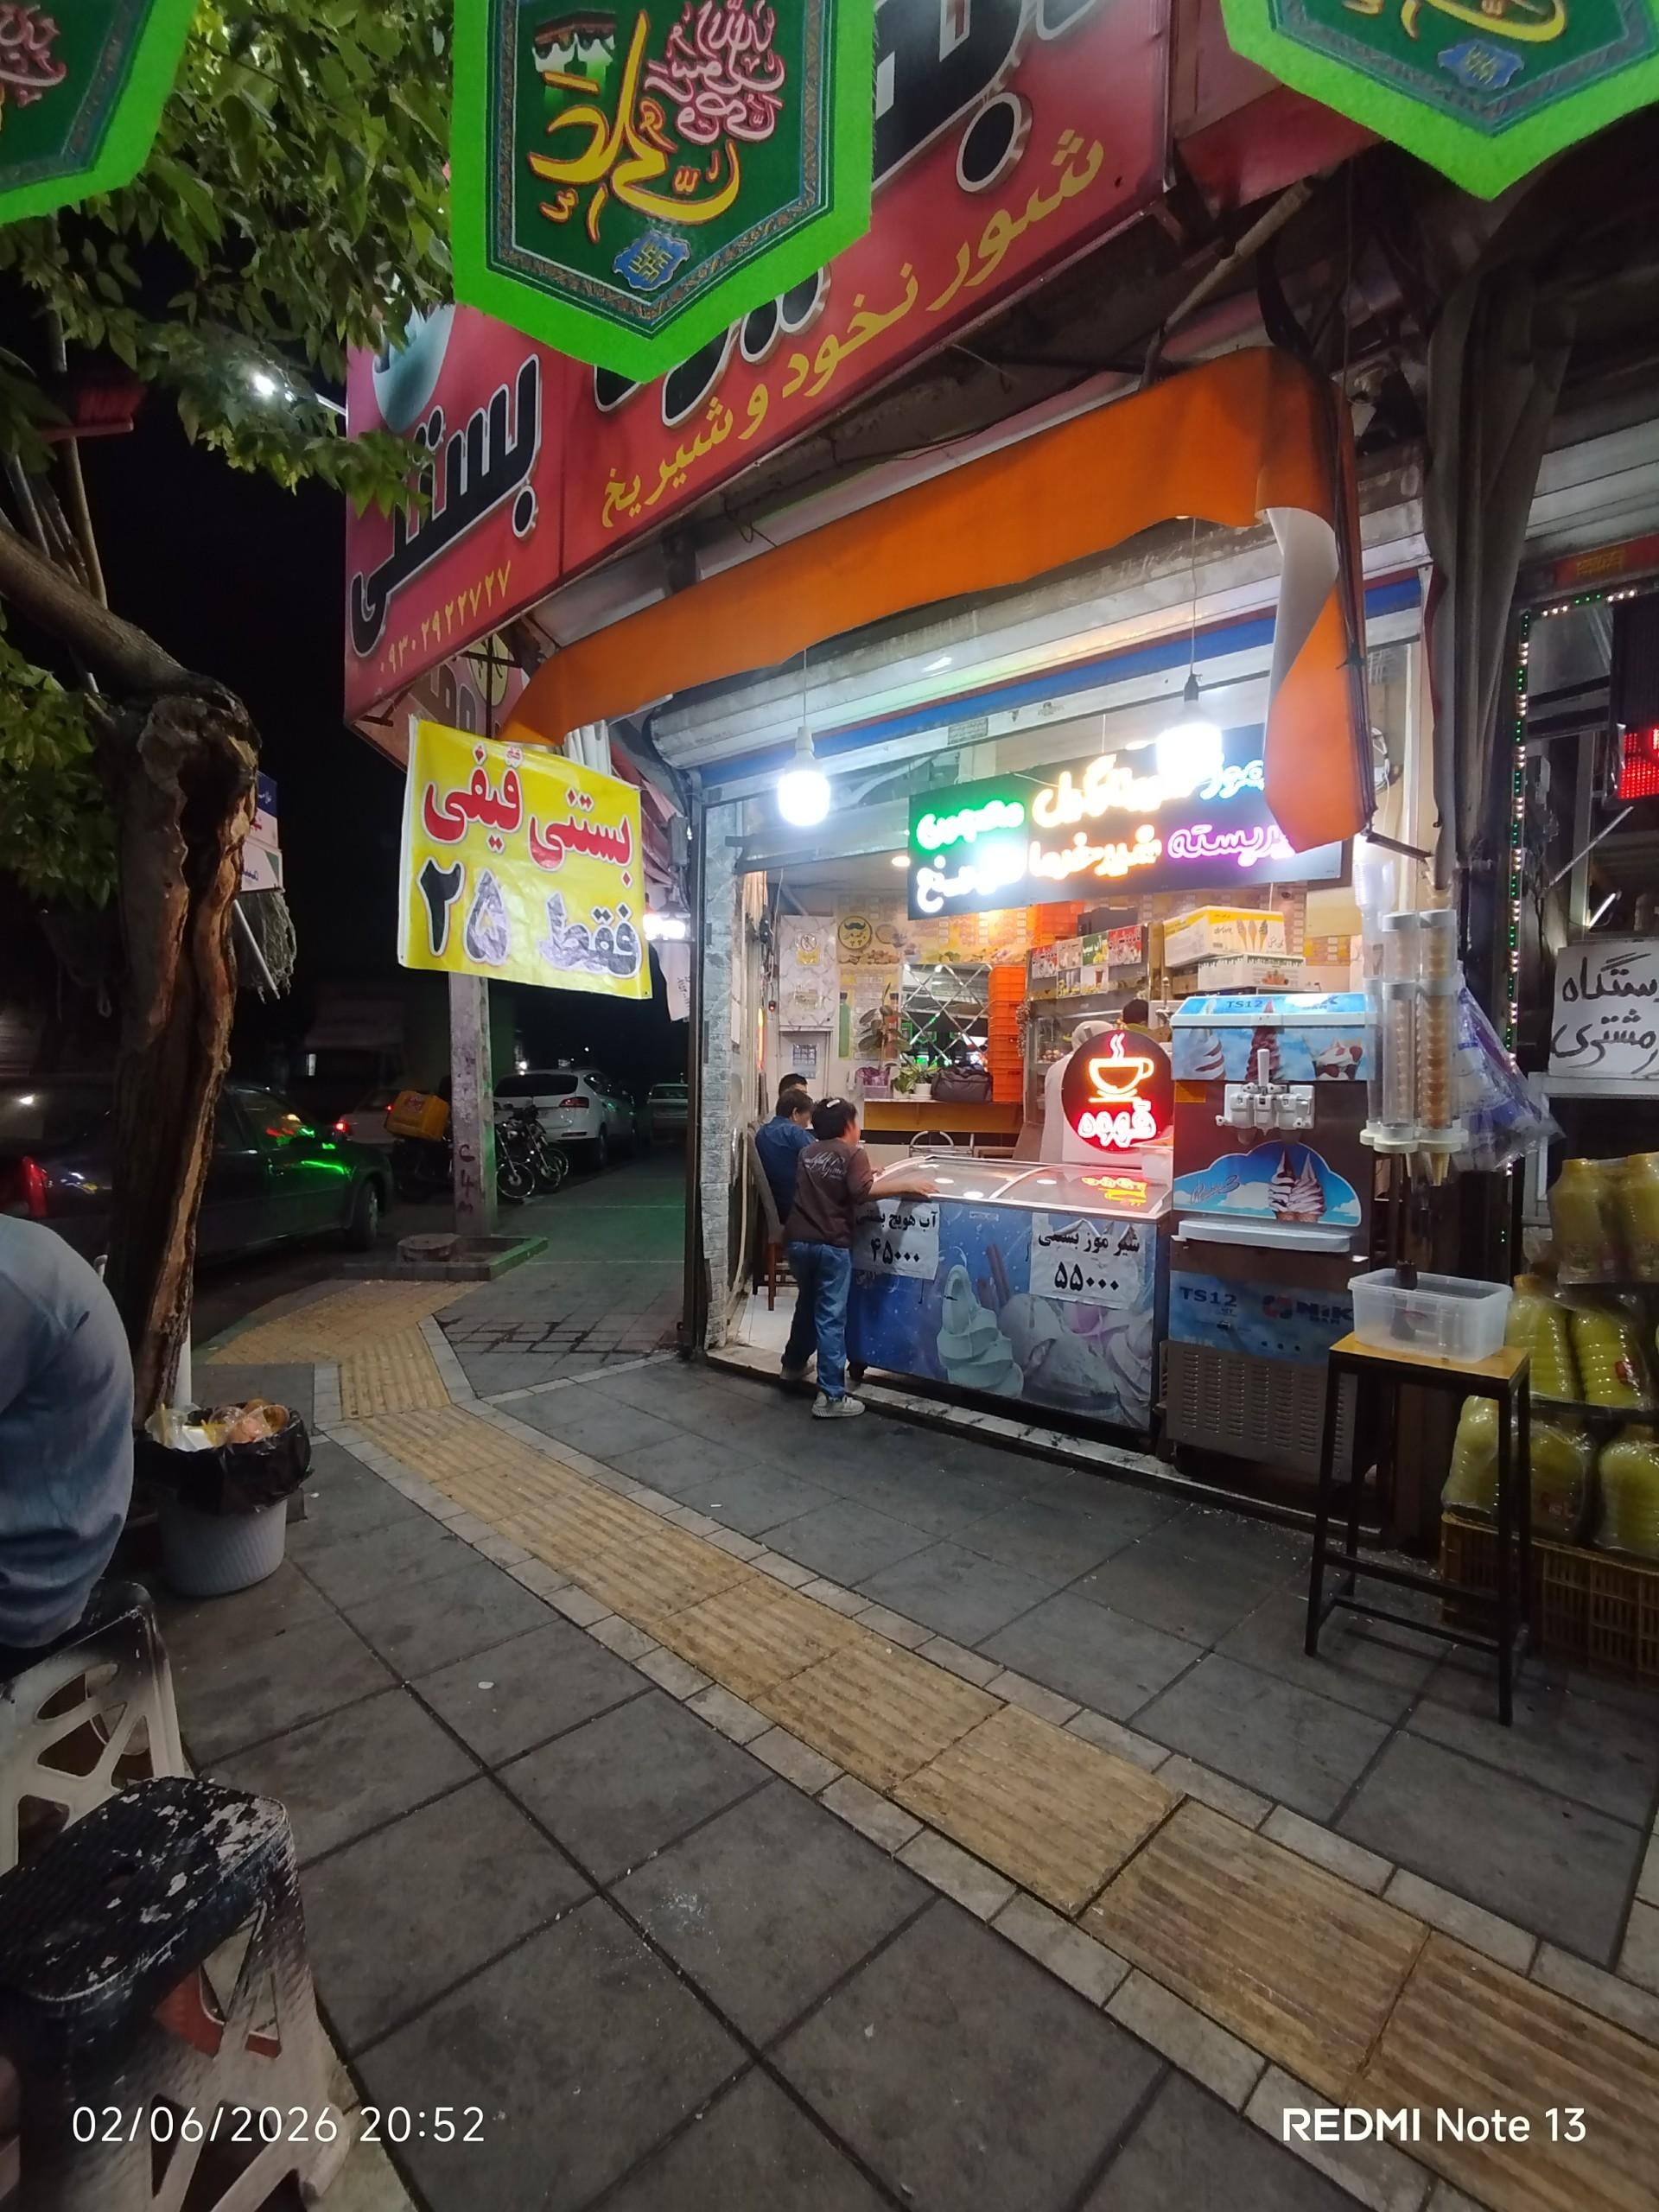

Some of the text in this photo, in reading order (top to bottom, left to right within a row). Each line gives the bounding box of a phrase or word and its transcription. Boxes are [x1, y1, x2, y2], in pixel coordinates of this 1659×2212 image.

[925, 129, 1104, 311] شور
[782, 262, 918, 398] نخود
[738, 383, 769, 440] و
[423, 744, 633, 887] بستنی قیفی
[416, 856, 643, 978] فقط ۲۵
[1561, 951, 1659, 1003] ستگاه
[1226, 1000, 1263, 1009] TS12
[1077, 1101, 1157, 1148] قهوه
[888, 1213, 916, 1231] هویج
[918, 1211, 938, 1232] آب
[870, 1237, 920, 1265] ۴۵۰۰۰
[1083, 1232, 1109, 1254] موز
[1113, 1233, 1141, 1256] شیر
[1054, 1261, 1120, 1292] ۵۵۰۰۰
[1179, 1286, 1237, 1307] TS12
